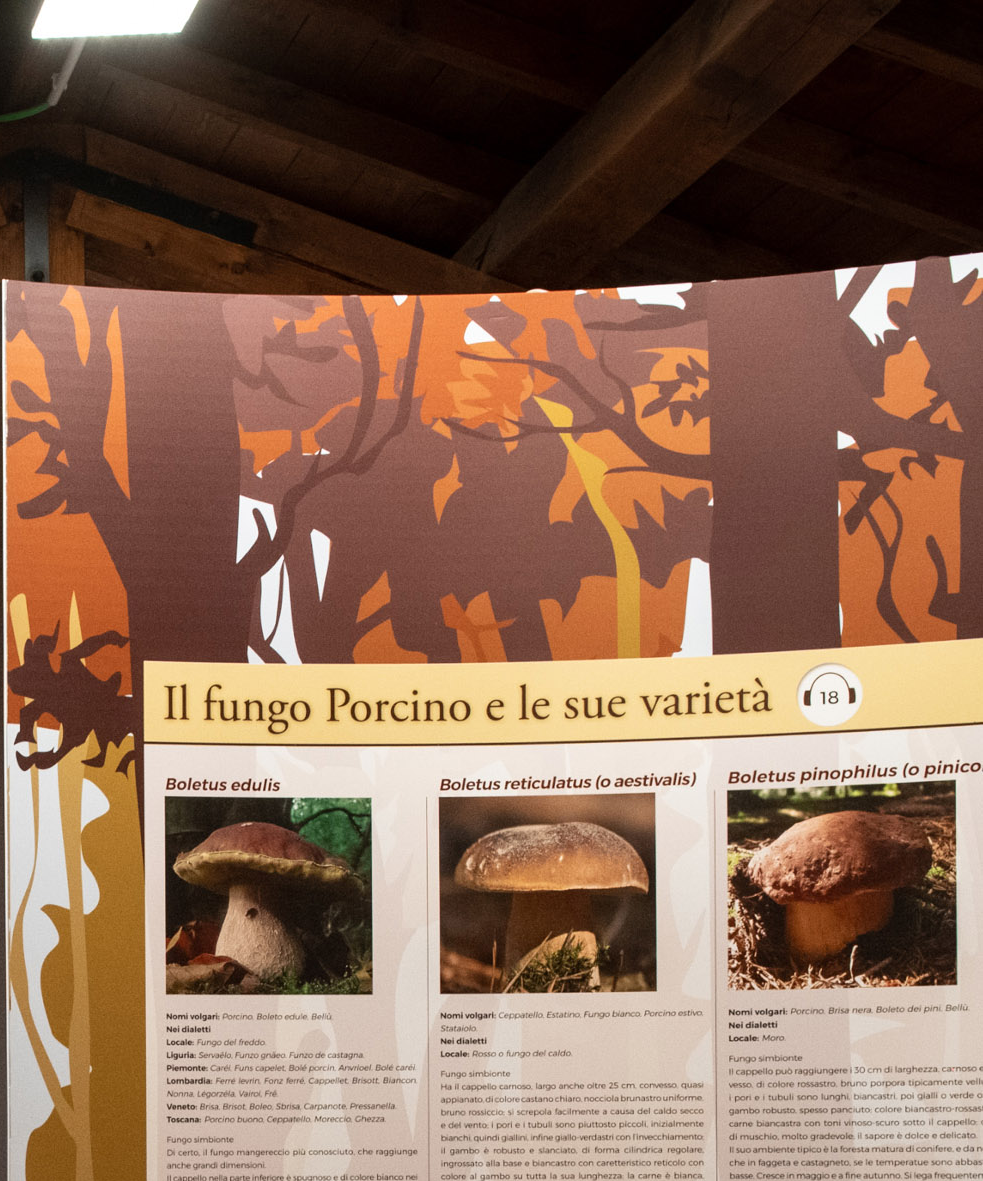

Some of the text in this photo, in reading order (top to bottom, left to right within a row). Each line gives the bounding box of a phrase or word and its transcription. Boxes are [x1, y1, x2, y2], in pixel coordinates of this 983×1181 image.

[820, 690, 839, 706] 18
[164, 677, 773, 735] Il fungo Porcino e le sue varietà
[728, 759, 983, 784] Boletus pinophilus (o pinico
[166, 777, 280, 792] Boletus edulis
[440, 772, 697, 791] Boletus reticulatus (o aestivalis)
[190, 1012, 222, 1022] volgari:
[440, 1011, 498, 1021] Nomi volgari:
[728, 1008, 789, 1017] Nomi volgari:
[166, 1025, 211, 1033] Nei dialetti
[728, 1021, 778, 1029] Nei dialetti
[166, 1038, 196, 1046] Locale:
[197, 1038, 222, 1048] Fungo
[456, 1037, 488, 1045] dialetti
[728, 1034, 761, 1042] Locale:
[440, 1050, 471, 1058] Locale:
[472, 1050, 497, 1058] Rosso
[506, 1050, 531, 1059] fungo
[729, 1054, 803, 1064] Fungo simbionte
[440, 1070, 511, 1080] Fungo simbionte
[166, 1136, 235, 1145] Fungo simbionte
[729, 1133, 738, 1141] di
[781, 1132, 809, 1141] molto
[858, 1132, 863, 1140] il
[865, 1133, 895, 1141] sapore
[897, 1132, 903, 1140] è
[904, 1132, 930, 1140] dolce
[167, 1149, 176, 1157] Di
[210, 1148, 235, 1158] fungo
[236, 1148, 291, 1158] mangereccio
[292, 1148, 306, 1157] più
[358, 1148, 374, 1156] che
[376, 1148, 418, 1157] raggiunge
[166, 1162, 192, 1170] anche
[192, 1162, 219, 1171] grandi
